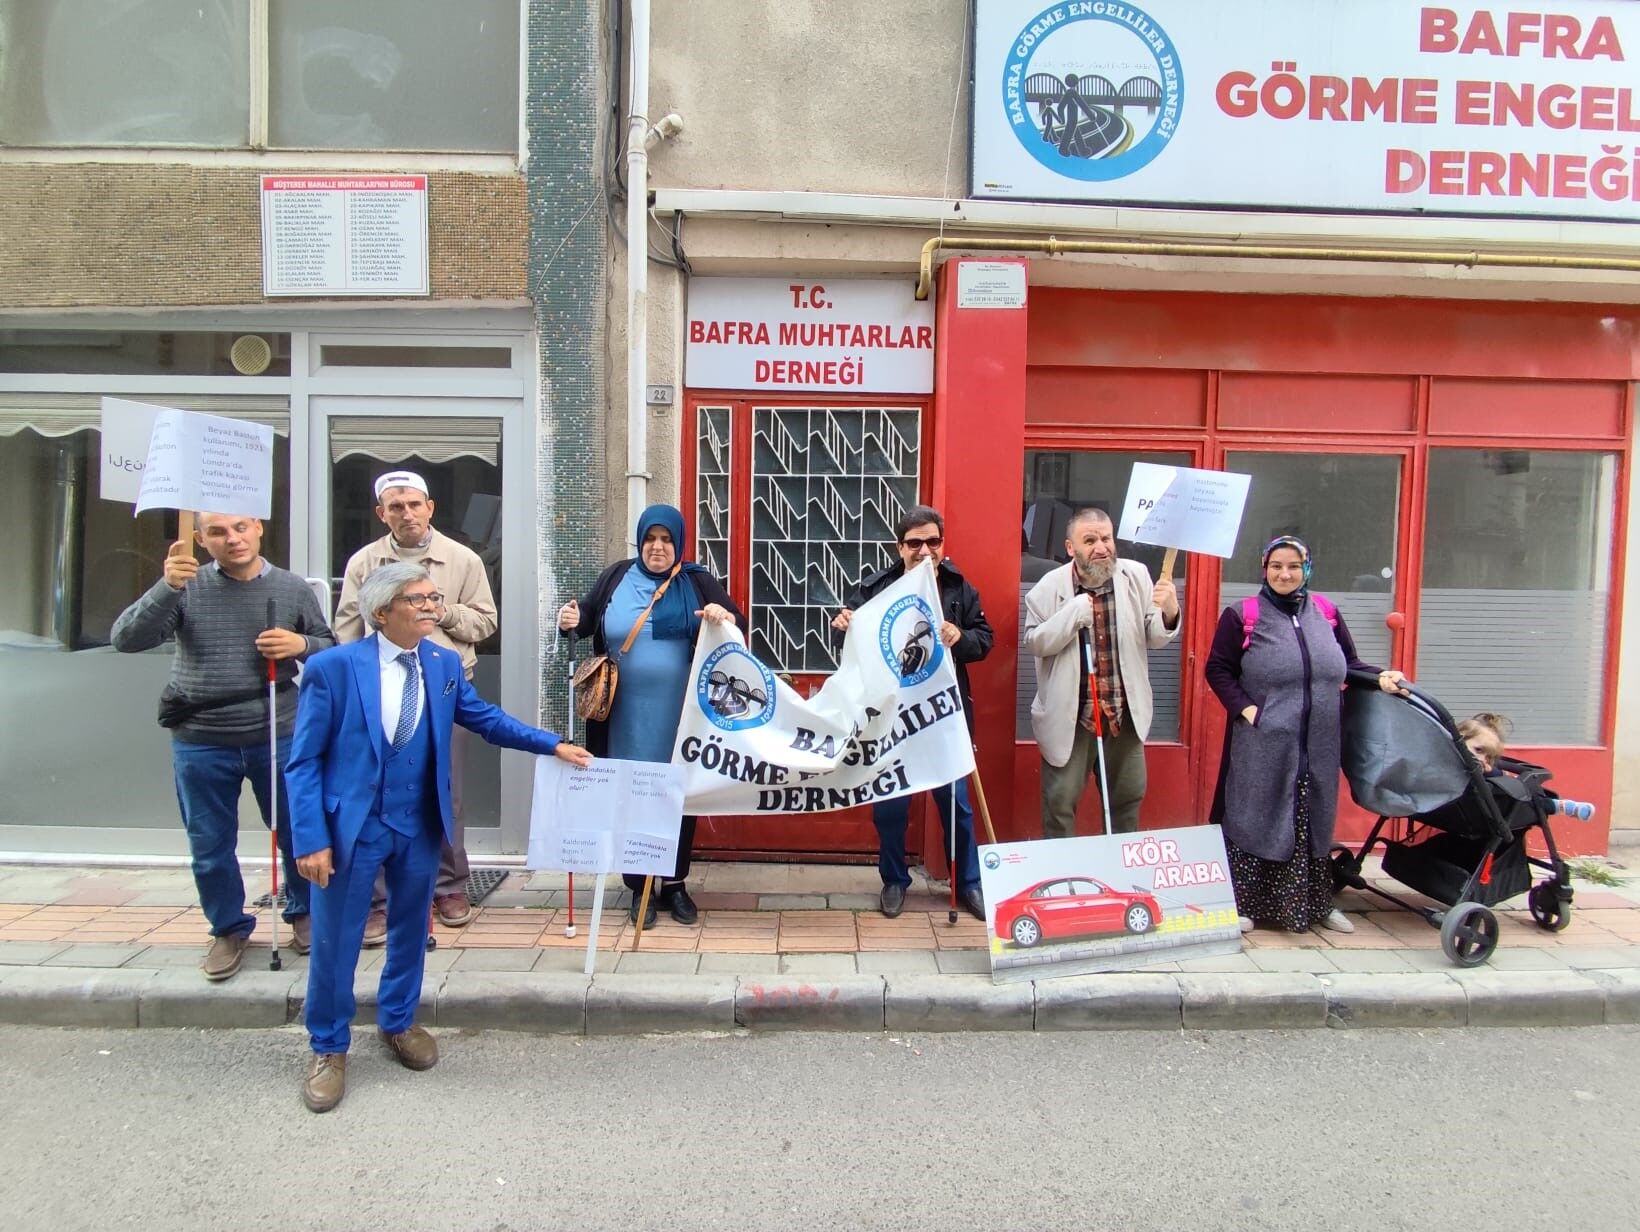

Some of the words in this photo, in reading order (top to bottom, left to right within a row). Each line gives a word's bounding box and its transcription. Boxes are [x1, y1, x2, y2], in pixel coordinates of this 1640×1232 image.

[1016, 6, 1067, 58] GÖRME
[1069, 2, 1166, 54] ENGELLİLER
[1419, 7, 1625, 62] BAFRA
[1007, 61, 1027, 125] BAFRA
[1156, 54, 1179, 140] DERNEĞİ
[1215, 61, 1439, 123] GÖRME
[1455, 80, 1640, 132] ENGEL
[789, 285, 833, 309] T.C.
[690, 321, 771, 345] BAFRA
[779, 323, 933, 349] MUHTARLAR
[755, 356, 864, 385] DERNEĞİ
[654, 390, 666, 401] 22
[909, 669, 929, 685] 2015
[716, 717, 733, 729] 2015
[681, 734, 789, 785] GÖRME
[756, 759, 911, 812] DERNEĞİ
[1122, 837, 1180, 869] KÖR
[1153, 861, 1227, 890] ARABA
